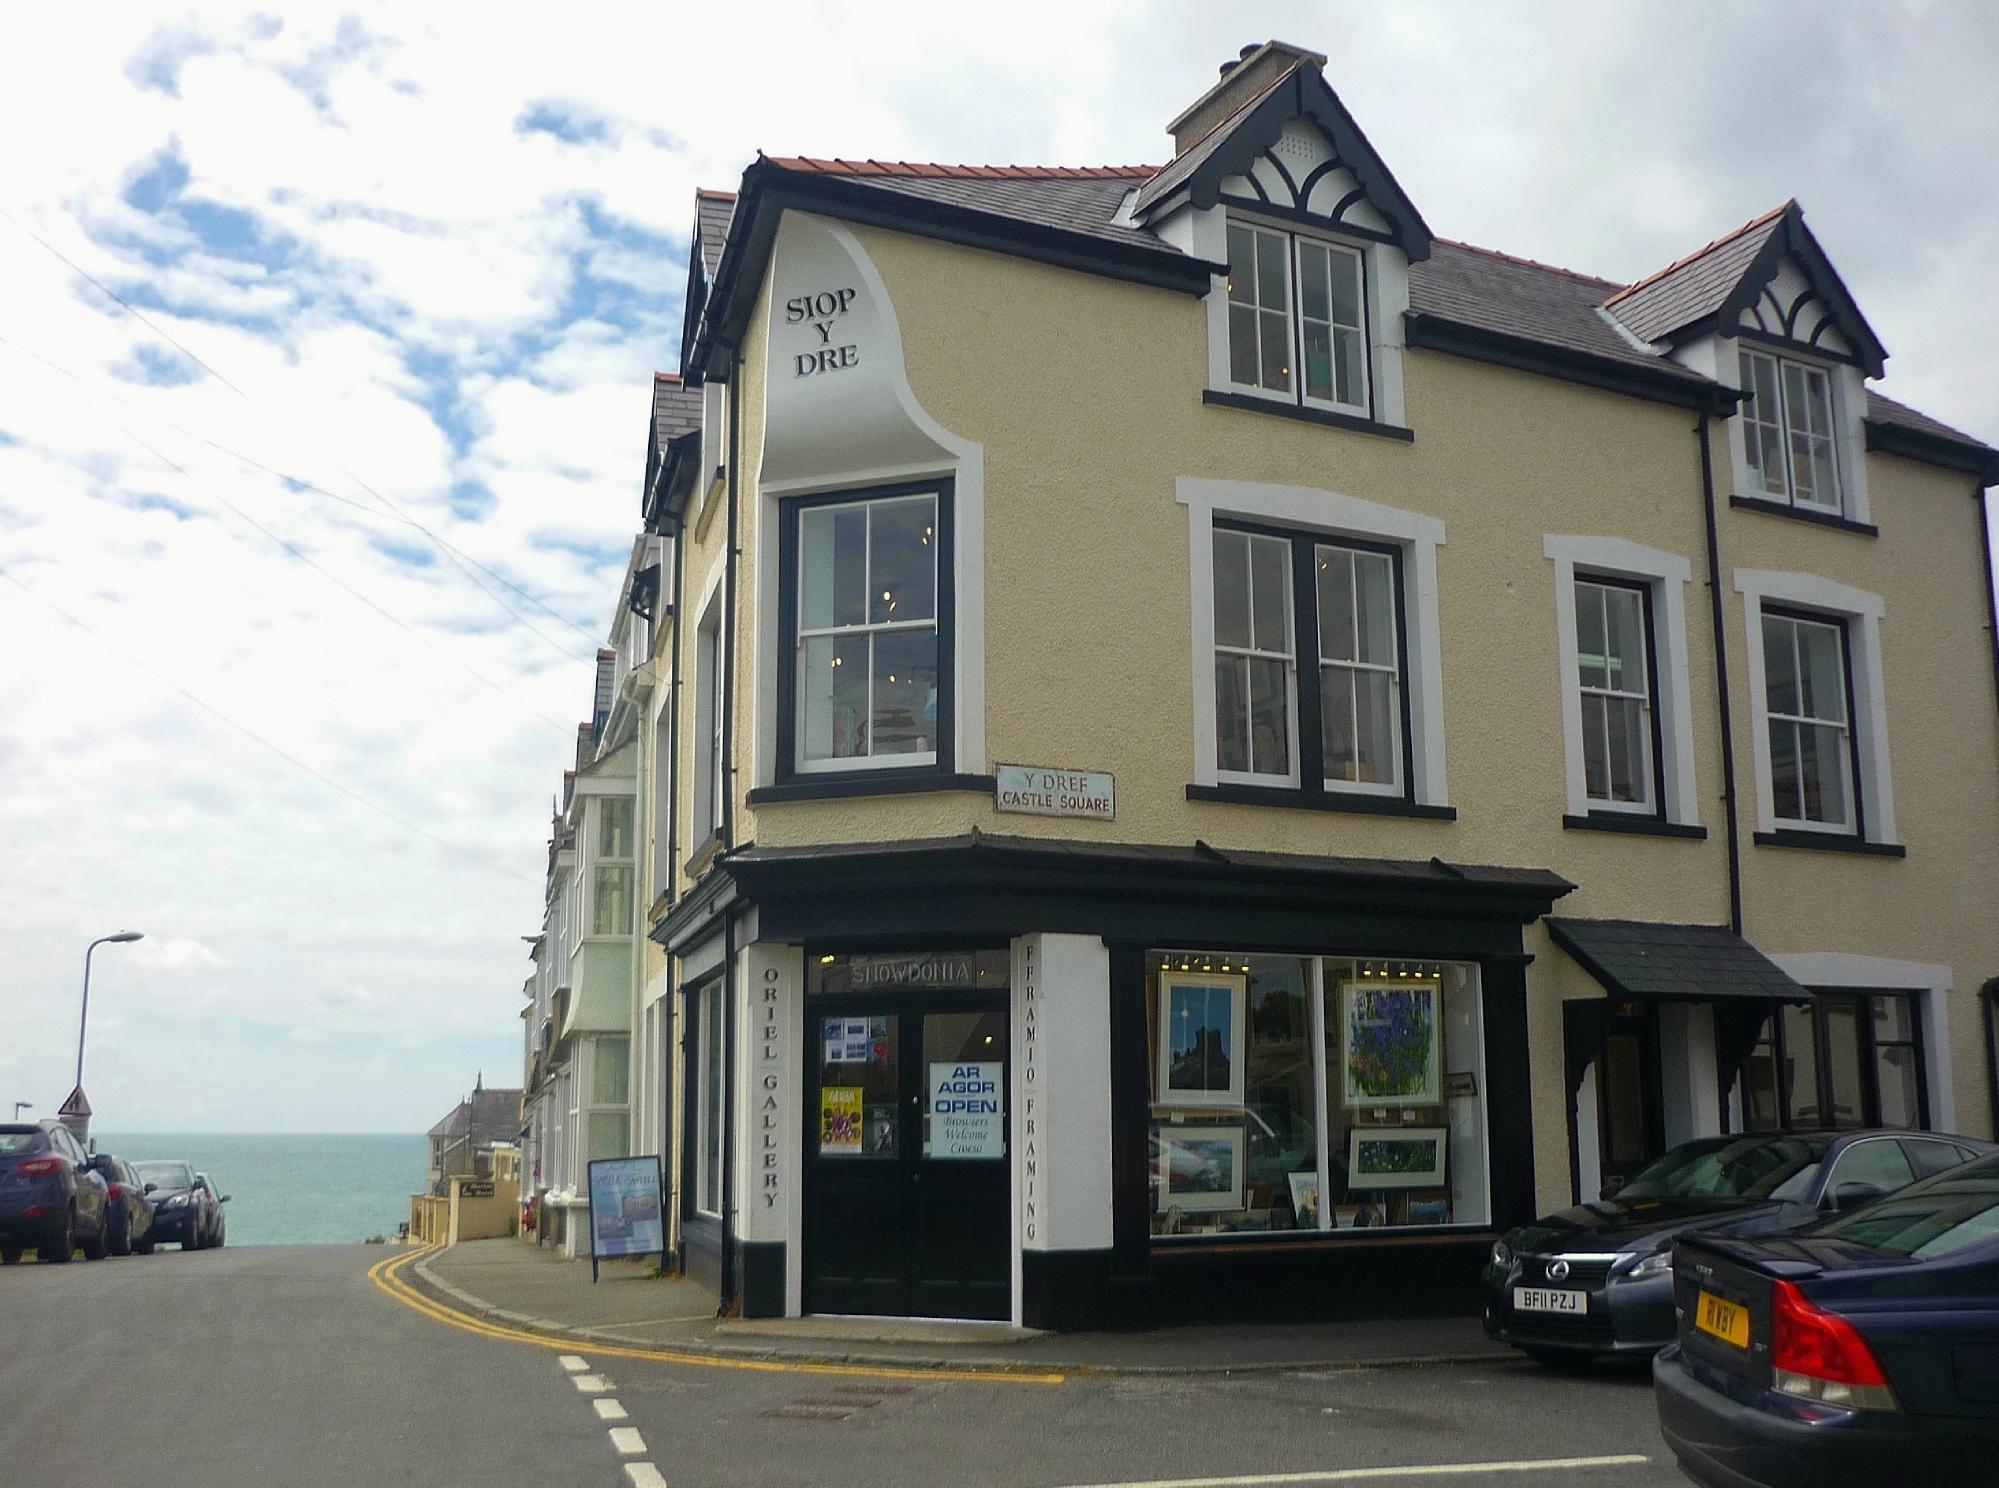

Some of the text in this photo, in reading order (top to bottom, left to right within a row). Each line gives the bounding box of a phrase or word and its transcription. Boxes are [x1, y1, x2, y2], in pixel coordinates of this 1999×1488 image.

[786, 288, 857, 324] SIOP
[814, 320, 835, 345] Y
[795, 345, 860, 378] DRE
[1024, 772, 1088, 792] Y DREF
[1002, 792, 1110, 812] CASTLE SQUARE
[952, 1066, 980, 1078] AR
[762, 968, 779, 1208] ORIEL GALLERY
[938, 1082, 995, 1093] AGOR
[1026, 946, 1037, 1240] FFRAMIO FRAMING
[935, 1100, 998, 1113] OPEN
[944, 1116, 988, 1126] Browsers
[945, 1127, 988, 1139] Welcome
[950, 1142, 982, 1154] Croeso
[1550, 1292, 1577, 1310] PZJ
